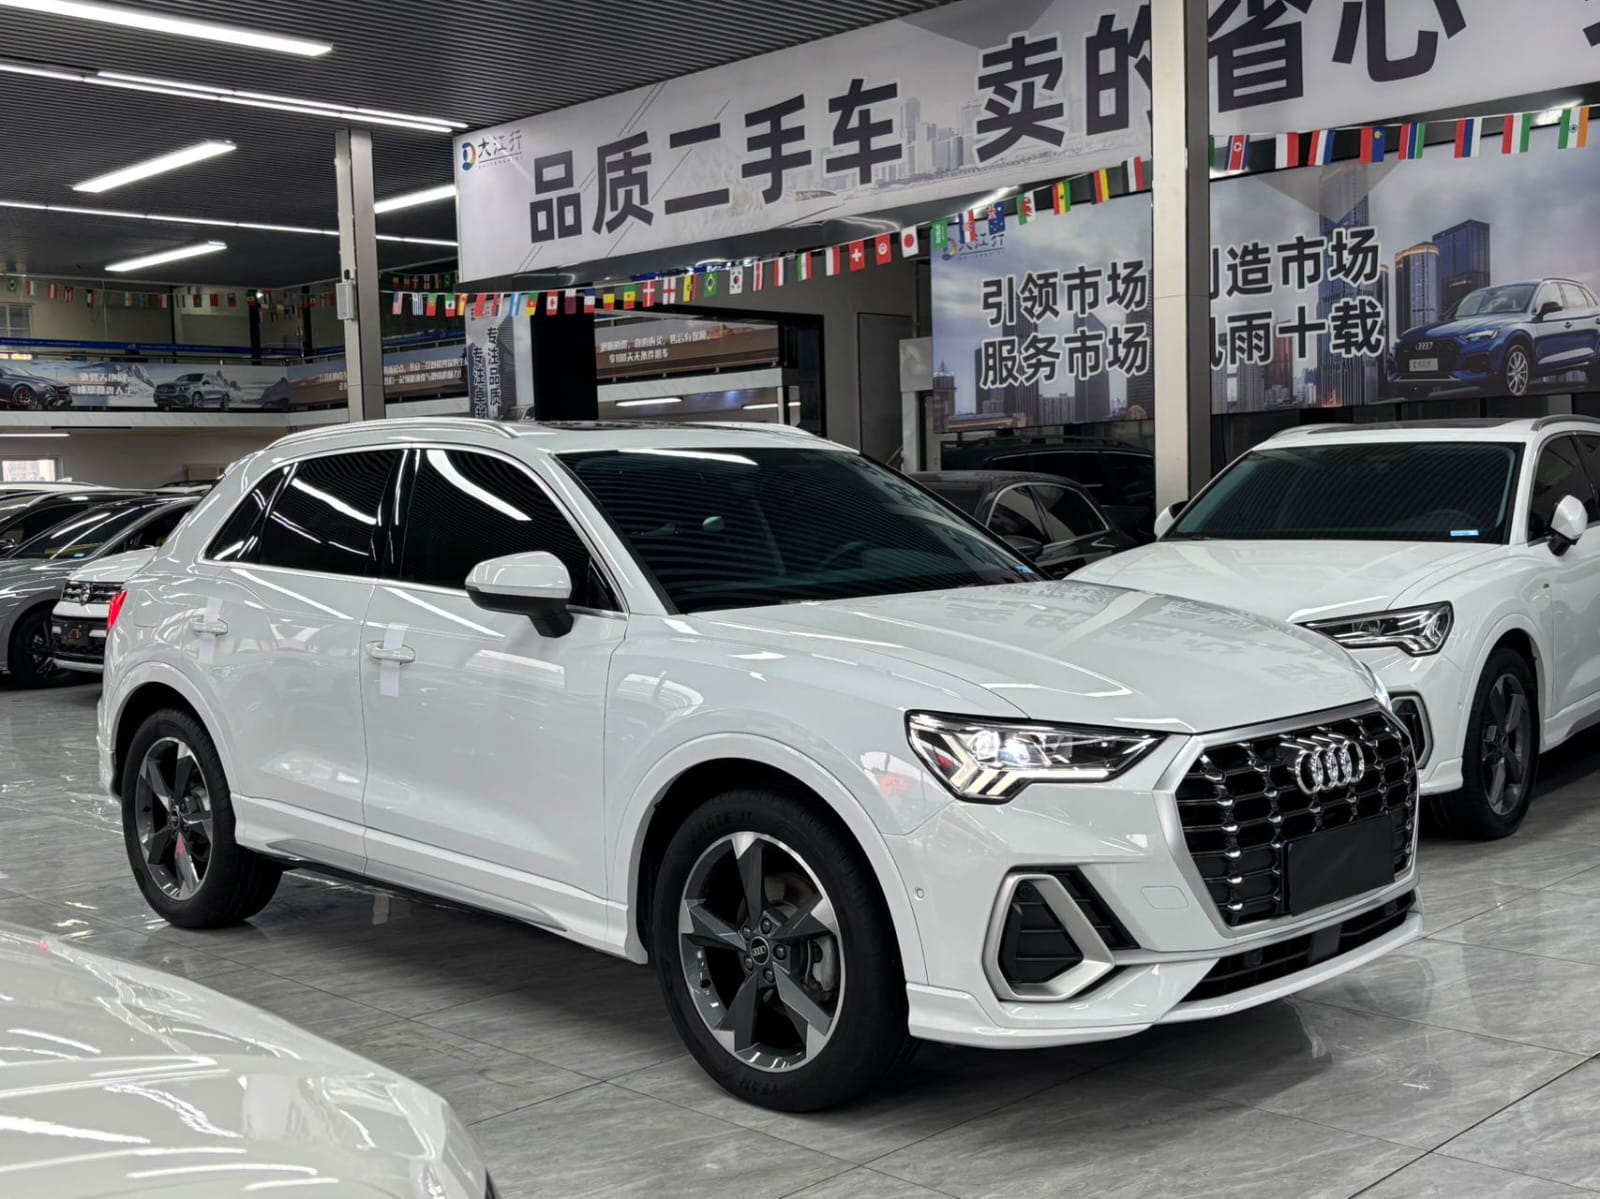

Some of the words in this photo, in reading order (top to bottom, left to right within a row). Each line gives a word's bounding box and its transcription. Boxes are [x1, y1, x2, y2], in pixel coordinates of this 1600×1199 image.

[478, 130, 523, 158] 大江行
[529, 78, 902, 244] 品质二手车
[982, 260, 1147, 326] 引领市场
[1210, 228, 1379, 300] 造市场
[981, 325, 1148, 387] 服务市场
